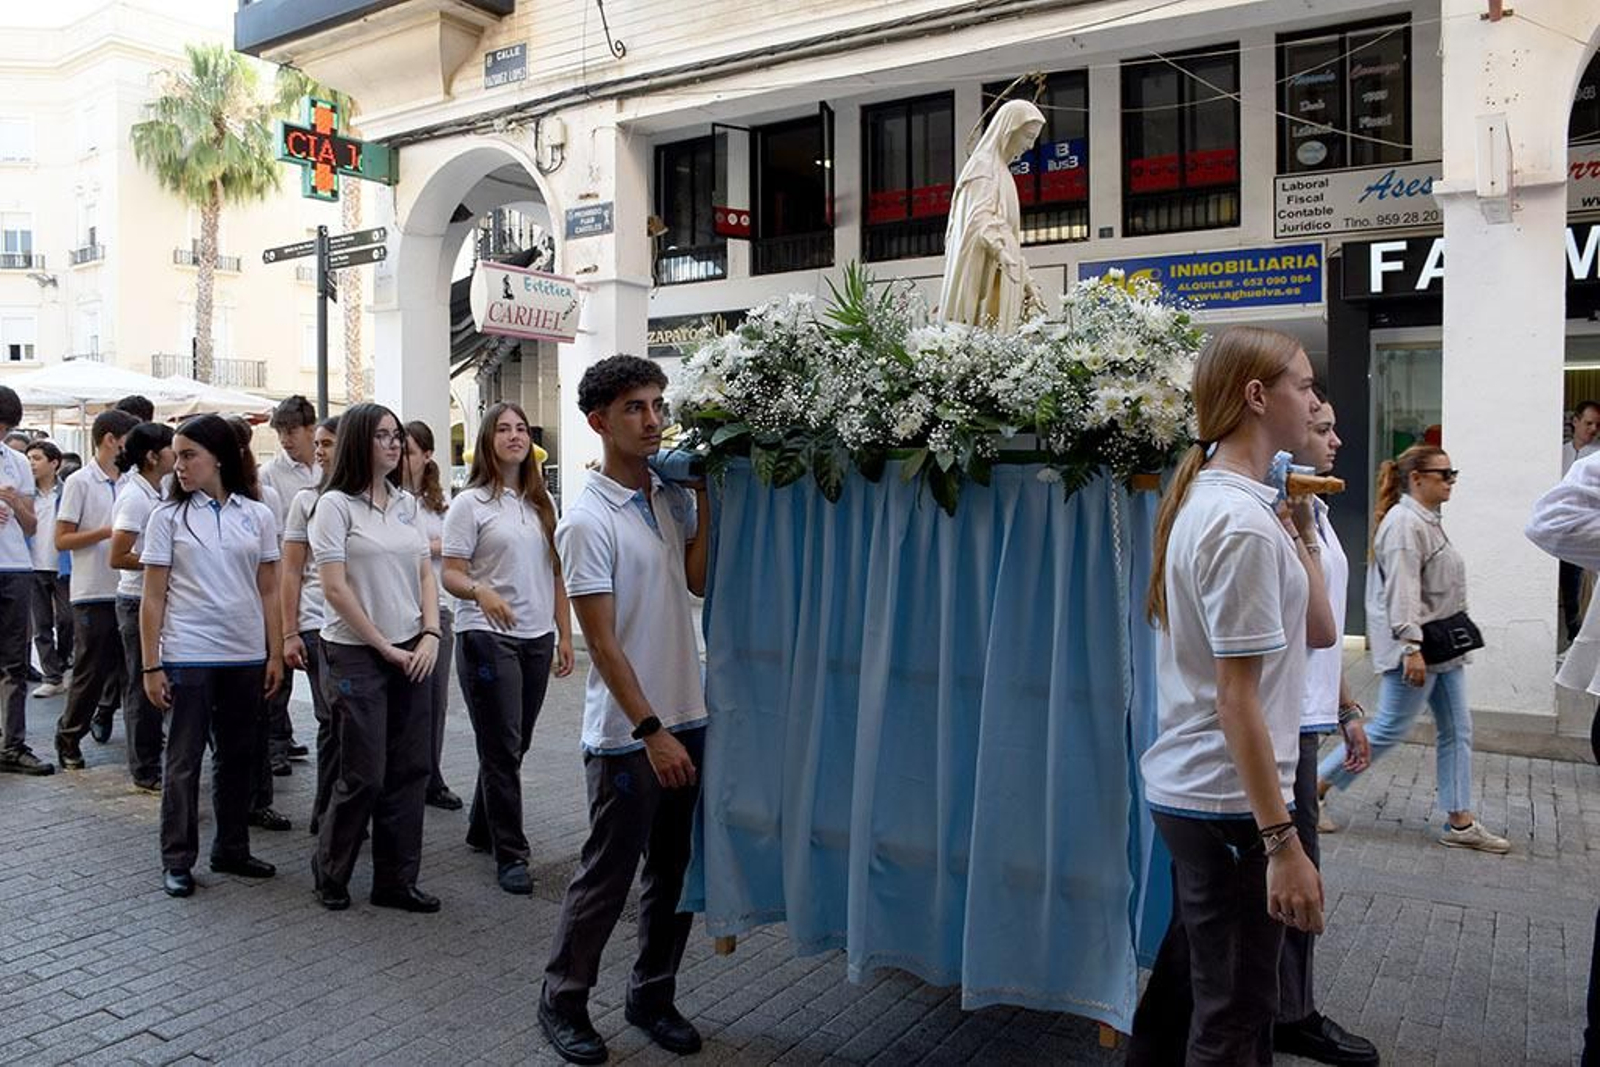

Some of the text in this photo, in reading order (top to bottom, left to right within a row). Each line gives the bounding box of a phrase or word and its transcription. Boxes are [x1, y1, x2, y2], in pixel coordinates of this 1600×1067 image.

[496, 46, 520, 61] CALLE
[287, 131, 337, 165] CIA
[1281, 178, 1329, 192] Laboral
[1358, 169, 1433, 204] Ases
[1286, 193, 1324, 205] Fiscal
[1277, 206, 1334, 219] Contable
[1376, 213, 1400, 226] 959
[1403, 212, 1419, 224] 28
[1423, 210, 1439, 222] 20
[1170, 254, 1319, 278] INMOBILIARIA
[1178, 280, 1233, 291] ALQUILER
[489, 301, 563, 332] CARHEL
